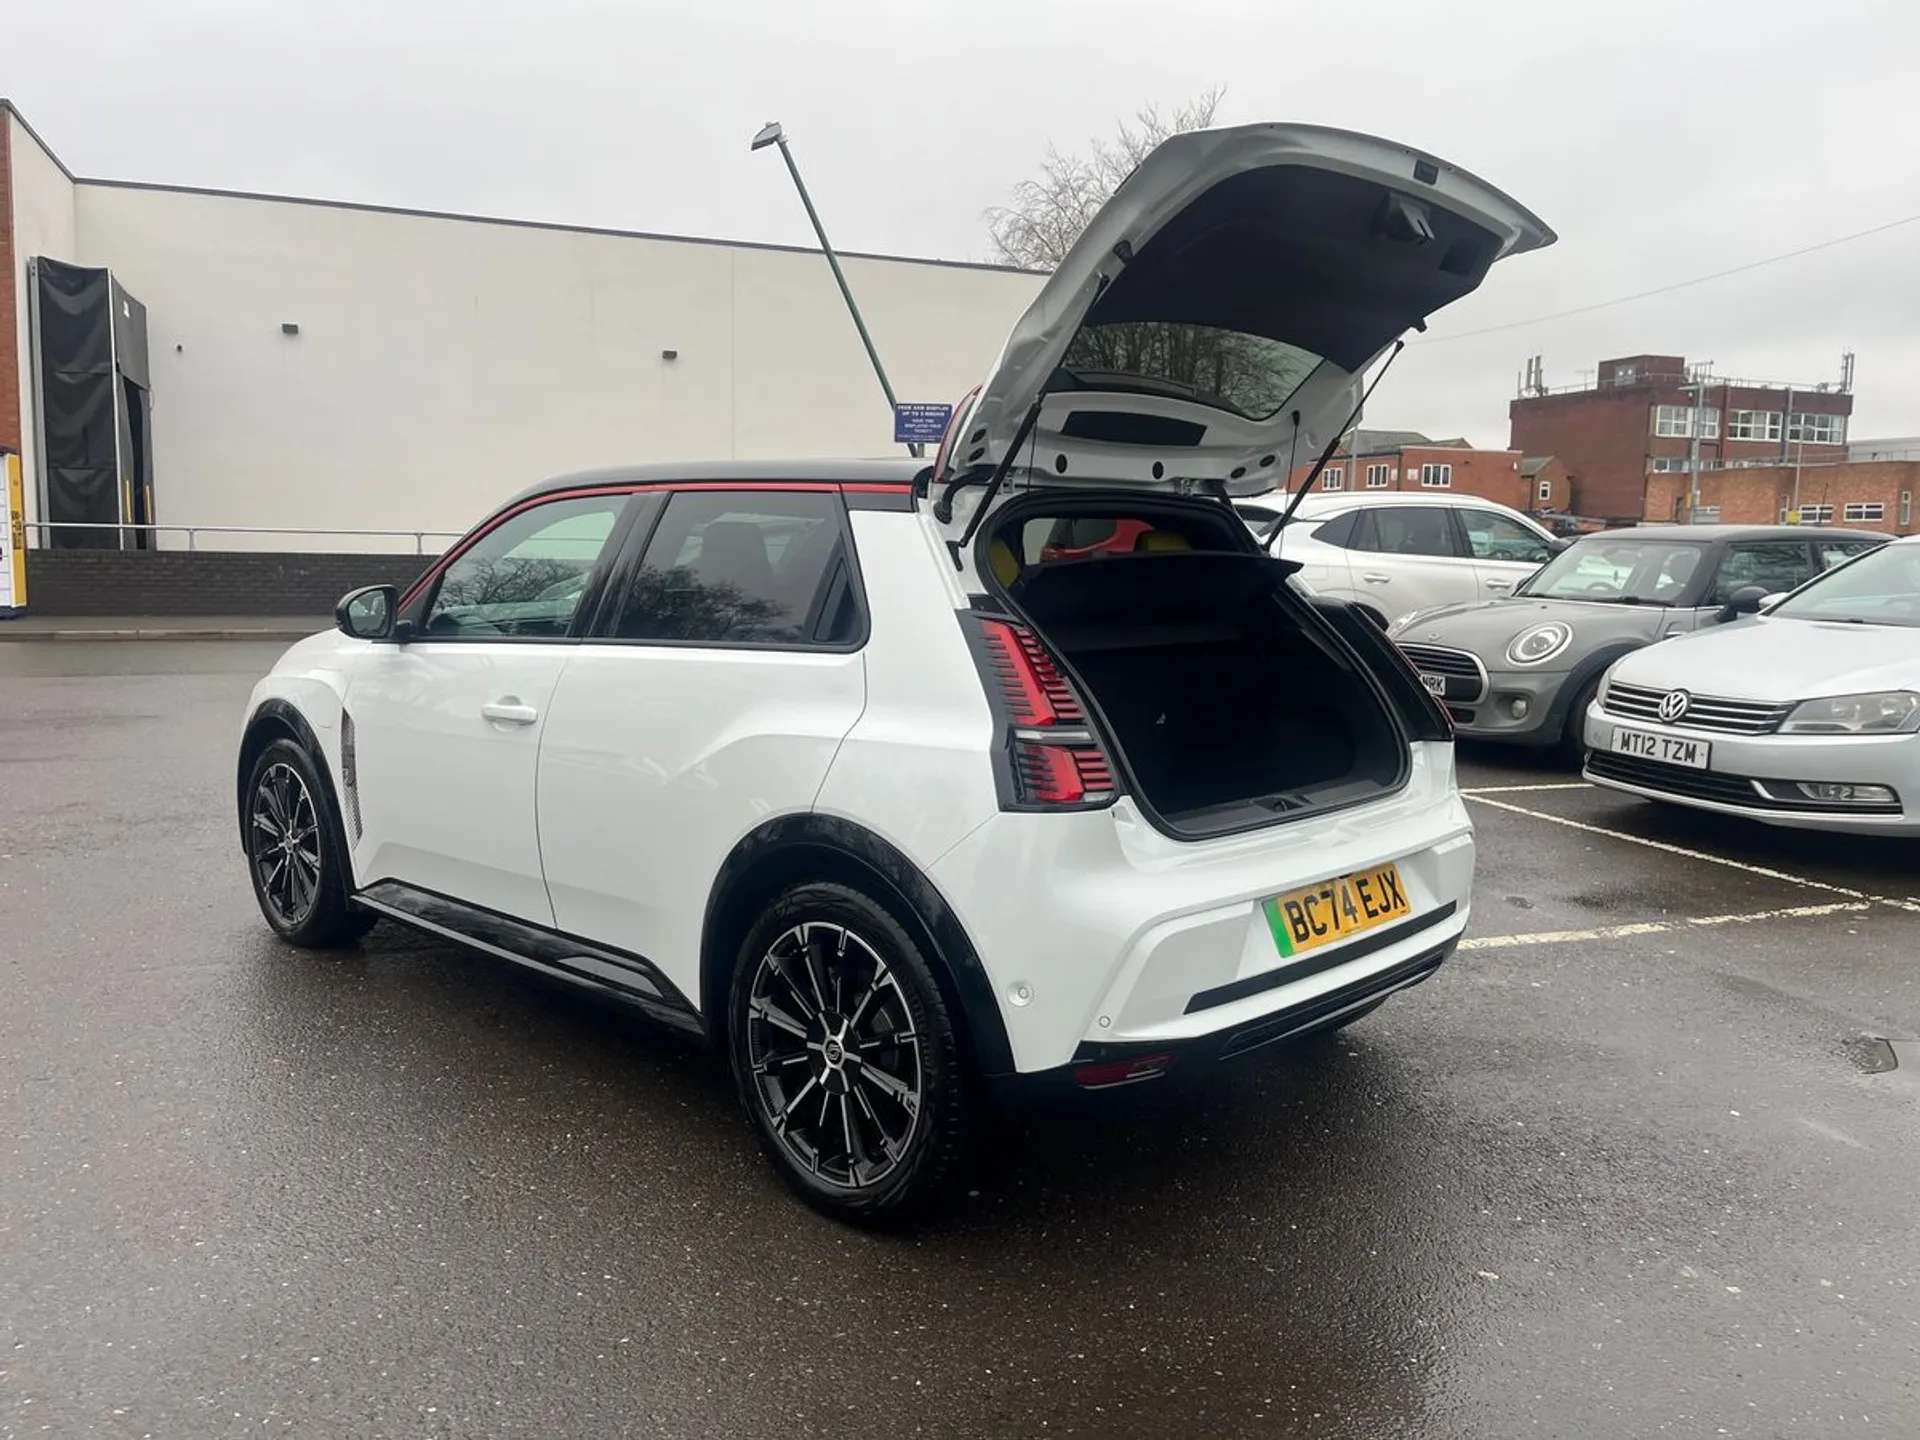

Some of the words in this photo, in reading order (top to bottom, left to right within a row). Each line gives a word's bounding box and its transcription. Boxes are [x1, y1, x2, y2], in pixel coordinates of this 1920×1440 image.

[1620, 731, 1656, 756] MT12
[1661, 739, 1697, 764] TZM
[1284, 886, 1358, 943] BC74
[1356, 870, 1406, 919] EJX
